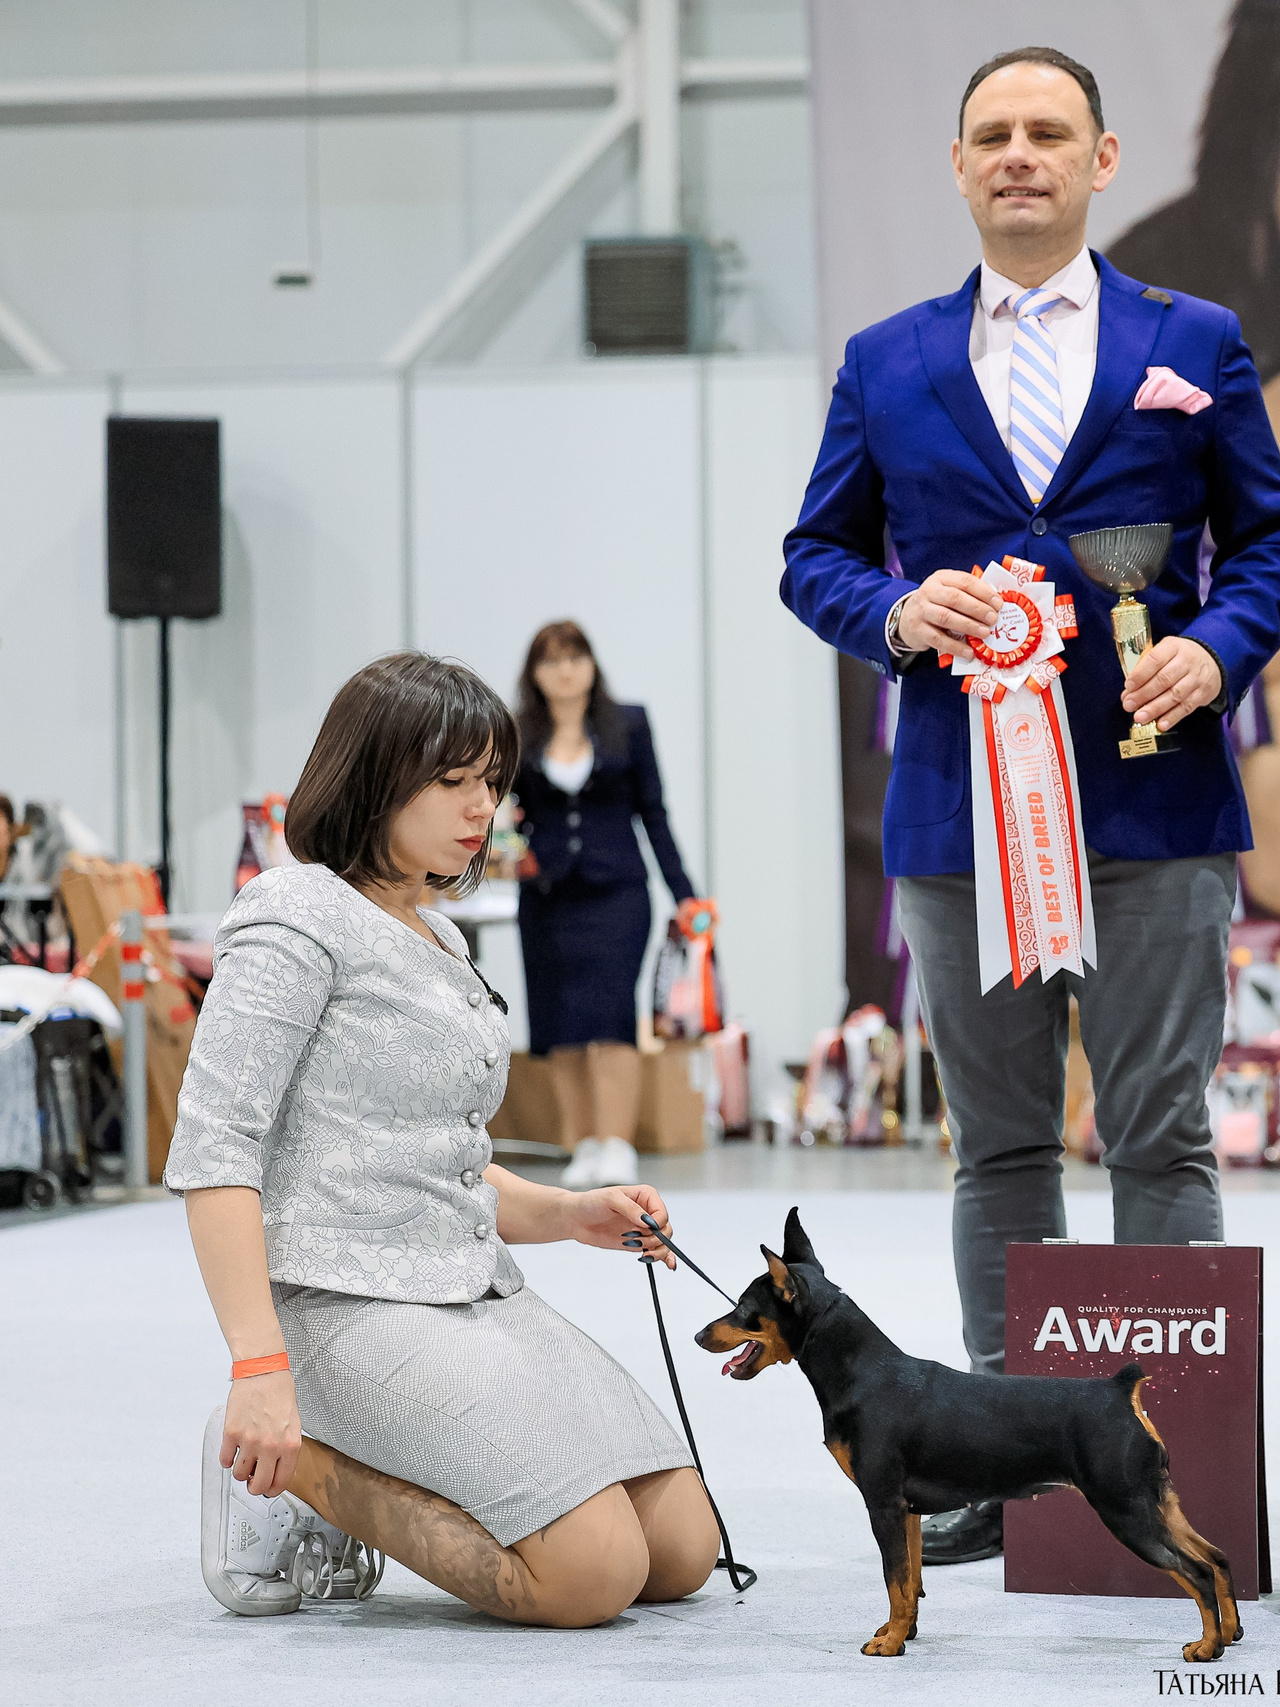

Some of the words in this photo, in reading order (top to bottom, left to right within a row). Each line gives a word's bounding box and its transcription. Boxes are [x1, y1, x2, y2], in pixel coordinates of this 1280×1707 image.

[1027, 791, 1051, 849] BREED
[1037, 853, 1055, 876] OF
[1042, 880, 1063, 923] BEST
[1077, 1306, 1121, 1314] QUALITY
[1124, 1306, 1144, 1314] FOR
[1147, 1307, 1208, 1315] CHAMPIONS
[1033, 1306, 1227, 1356] Award
[240, 1520, 249, 1552] adidas
